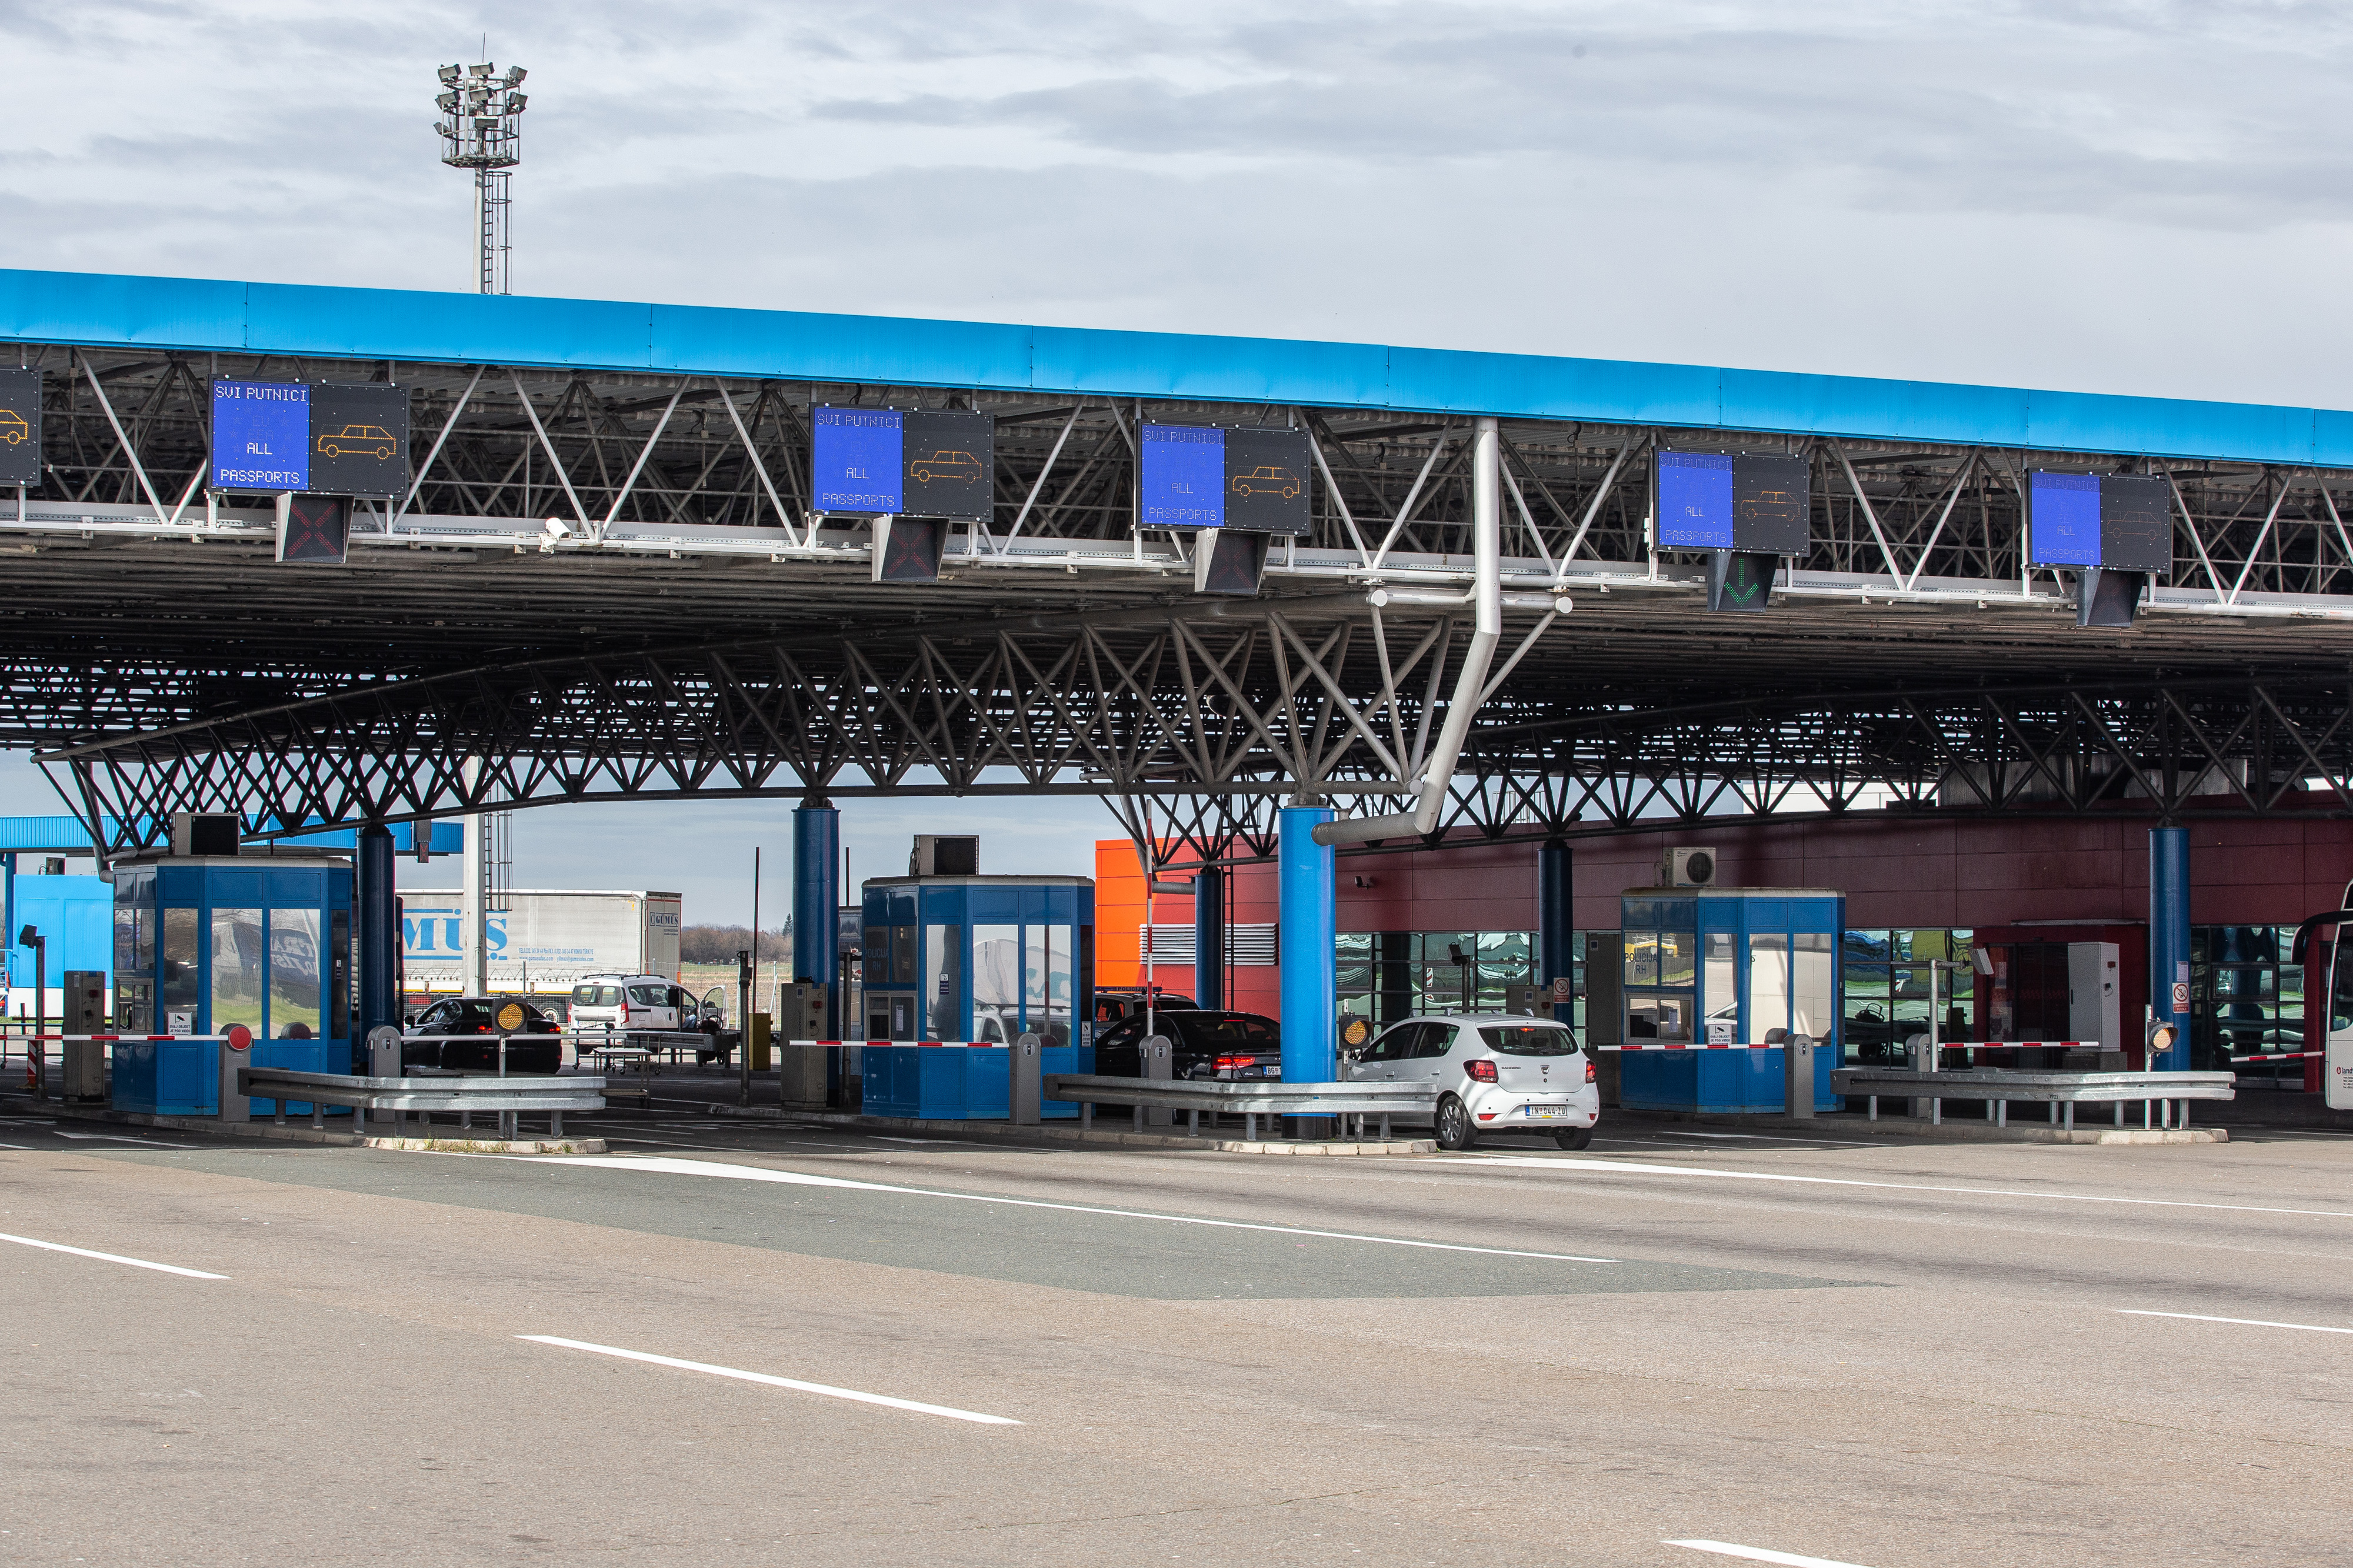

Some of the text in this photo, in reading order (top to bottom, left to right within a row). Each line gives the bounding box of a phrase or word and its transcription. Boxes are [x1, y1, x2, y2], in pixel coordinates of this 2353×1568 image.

[215, 386, 306, 402] SVI PUTNICI
[817, 413, 900, 428] SVI PUTNICI
[1144, 431, 1222, 445] SVI PUTNICI
[246, 442, 273, 455] ALL
[1660, 457, 1731, 471] SVI PUTNICI
[221, 469, 300, 484] PASSPORTS
[846, 467, 870, 479] ALL
[1171, 482, 1194, 494] ALL
[2034, 478, 2098, 492] SVI PUTNICI
[823, 493, 895, 506] PASSPORTS
[1149, 507, 1217, 521] PASSPORTS
[1685, 506, 1705, 517] ALL
[1666, 530, 1727, 542] PASSPORTS
[2057, 525, 2076, 536] ALL
[2039, 548, 2095, 560] PASSPORTS
[865, 948, 889, 958] POLICIJA
[1625, 953, 1658, 963] POLICIJA
[873, 961, 881, 970] RH
[1636, 965, 1646, 974] RH
